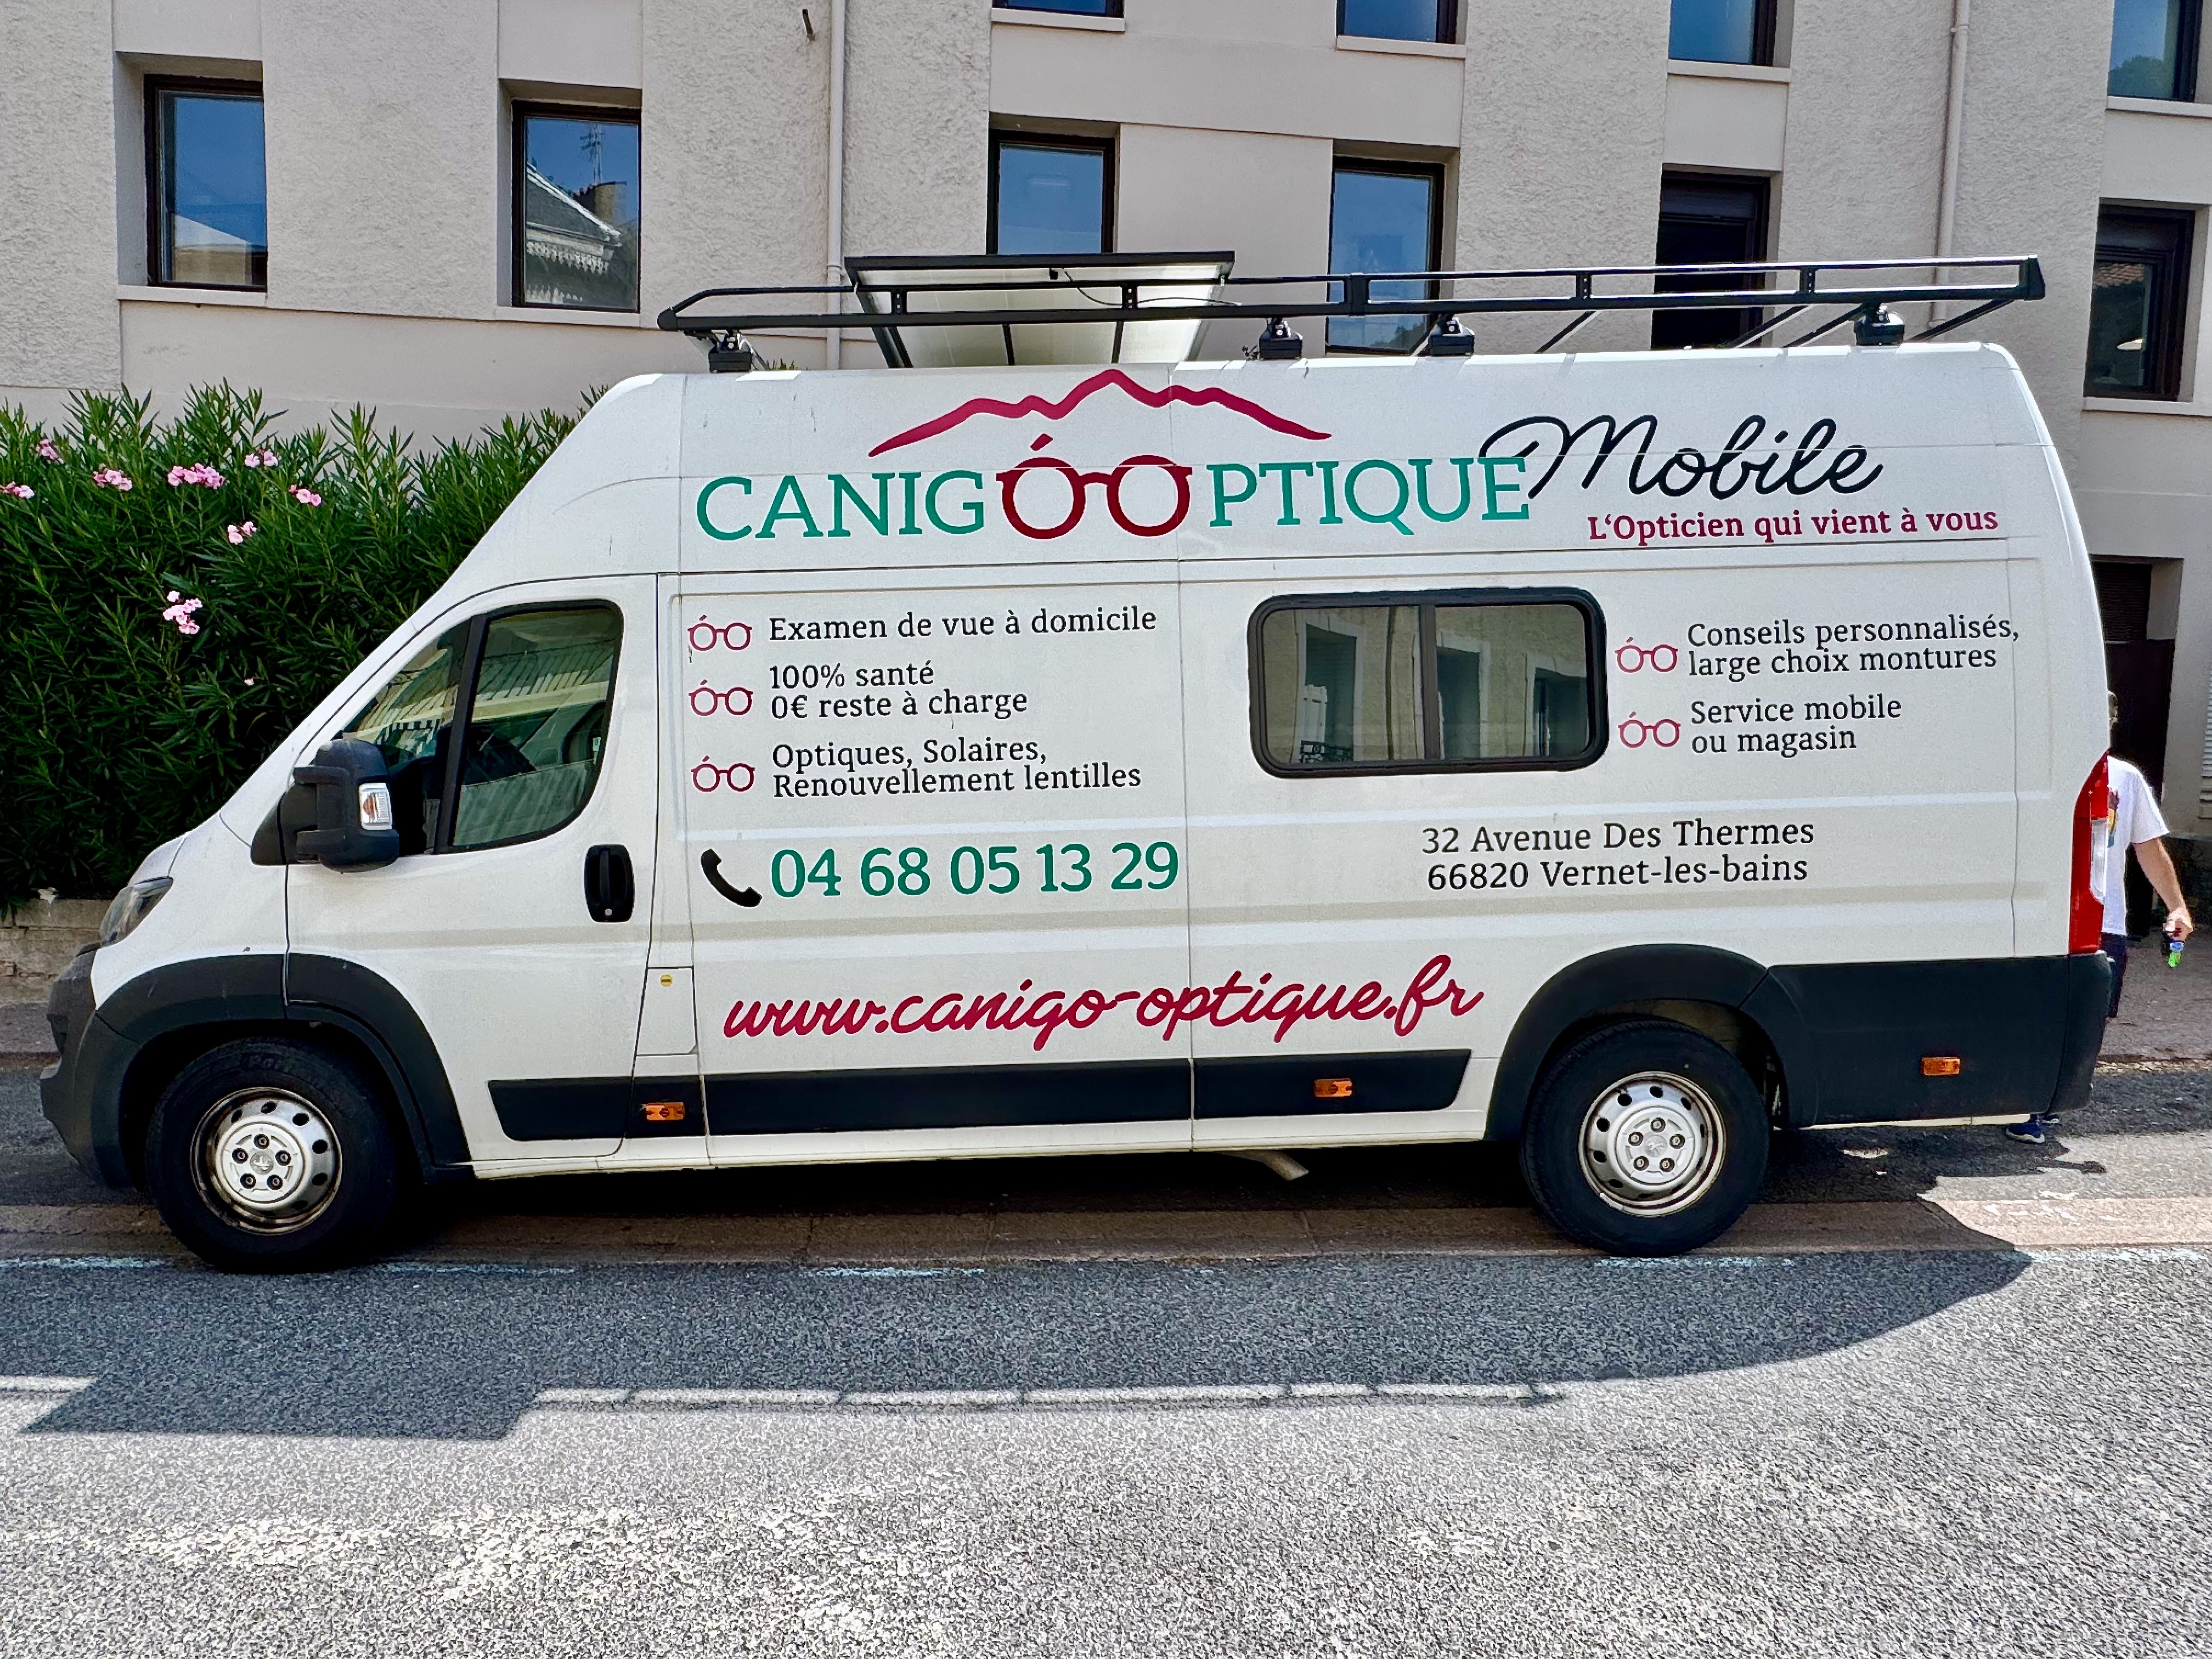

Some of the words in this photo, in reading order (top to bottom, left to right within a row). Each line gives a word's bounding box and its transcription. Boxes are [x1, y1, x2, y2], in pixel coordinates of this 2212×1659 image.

[1477, 415, 1884, 500] Mobile
[1754, 509, 1803, 543] qui
[1810, 508, 1892, 534] vient
[1900, 507, 1918, 533] à
[1926, 511, 1998, 532] vous
[769, 618, 888, 641] Examen
[898, 611, 932, 637] de
[941, 617, 994, 636] vue
[1005, 609, 1021, 634] à
[1031, 605, 1156, 633] domicile
[1688, 619, 1805, 647] Conseils
[1815, 613, 2019, 653] personnalisés,
[769, 663, 845, 689] 100%
[856, 659, 934, 687] santé
[1689, 651, 1761, 682] large
[1771, 647, 1850, 674] choix
[1859, 647, 1997, 671] montures
[771, 695, 808, 720] 0€
[819, 695, 892, 718] reste
[902, 690, 918, 715] à
[928, 688, 1027, 720] charge
[1691, 698, 1794, 724] Service
[1804, 692, 1901, 721] mobile
[772, 741, 912, 775] Optiques,
[923, 736, 1046, 765] Solaires,
[1692, 735, 1727, 754] ou
[1737, 724, 1857, 758] magasin
[773, 768, 1015, 798] Renouvellement
[1024, 761, 1141, 790] lentilles
[1422, 827, 1459, 854] 32
[1470, 826, 1591, 853] Avenue
[1603, 823, 1661, 849] Des
[1672, 817, 1814, 847] Thermes
[771, 848, 842, 898] 04
[860, 847, 930, 896] 68
[950, 846, 1020, 895] 05
[1036, 843, 1092, 893] 13
[1110, 842, 1178, 890] 29
[1427, 861, 1528, 890] 66820
[1539, 854, 1807, 887] Vernet-les-bains
[723, 955, 1485, 1052] www.canigo-optique.fr
